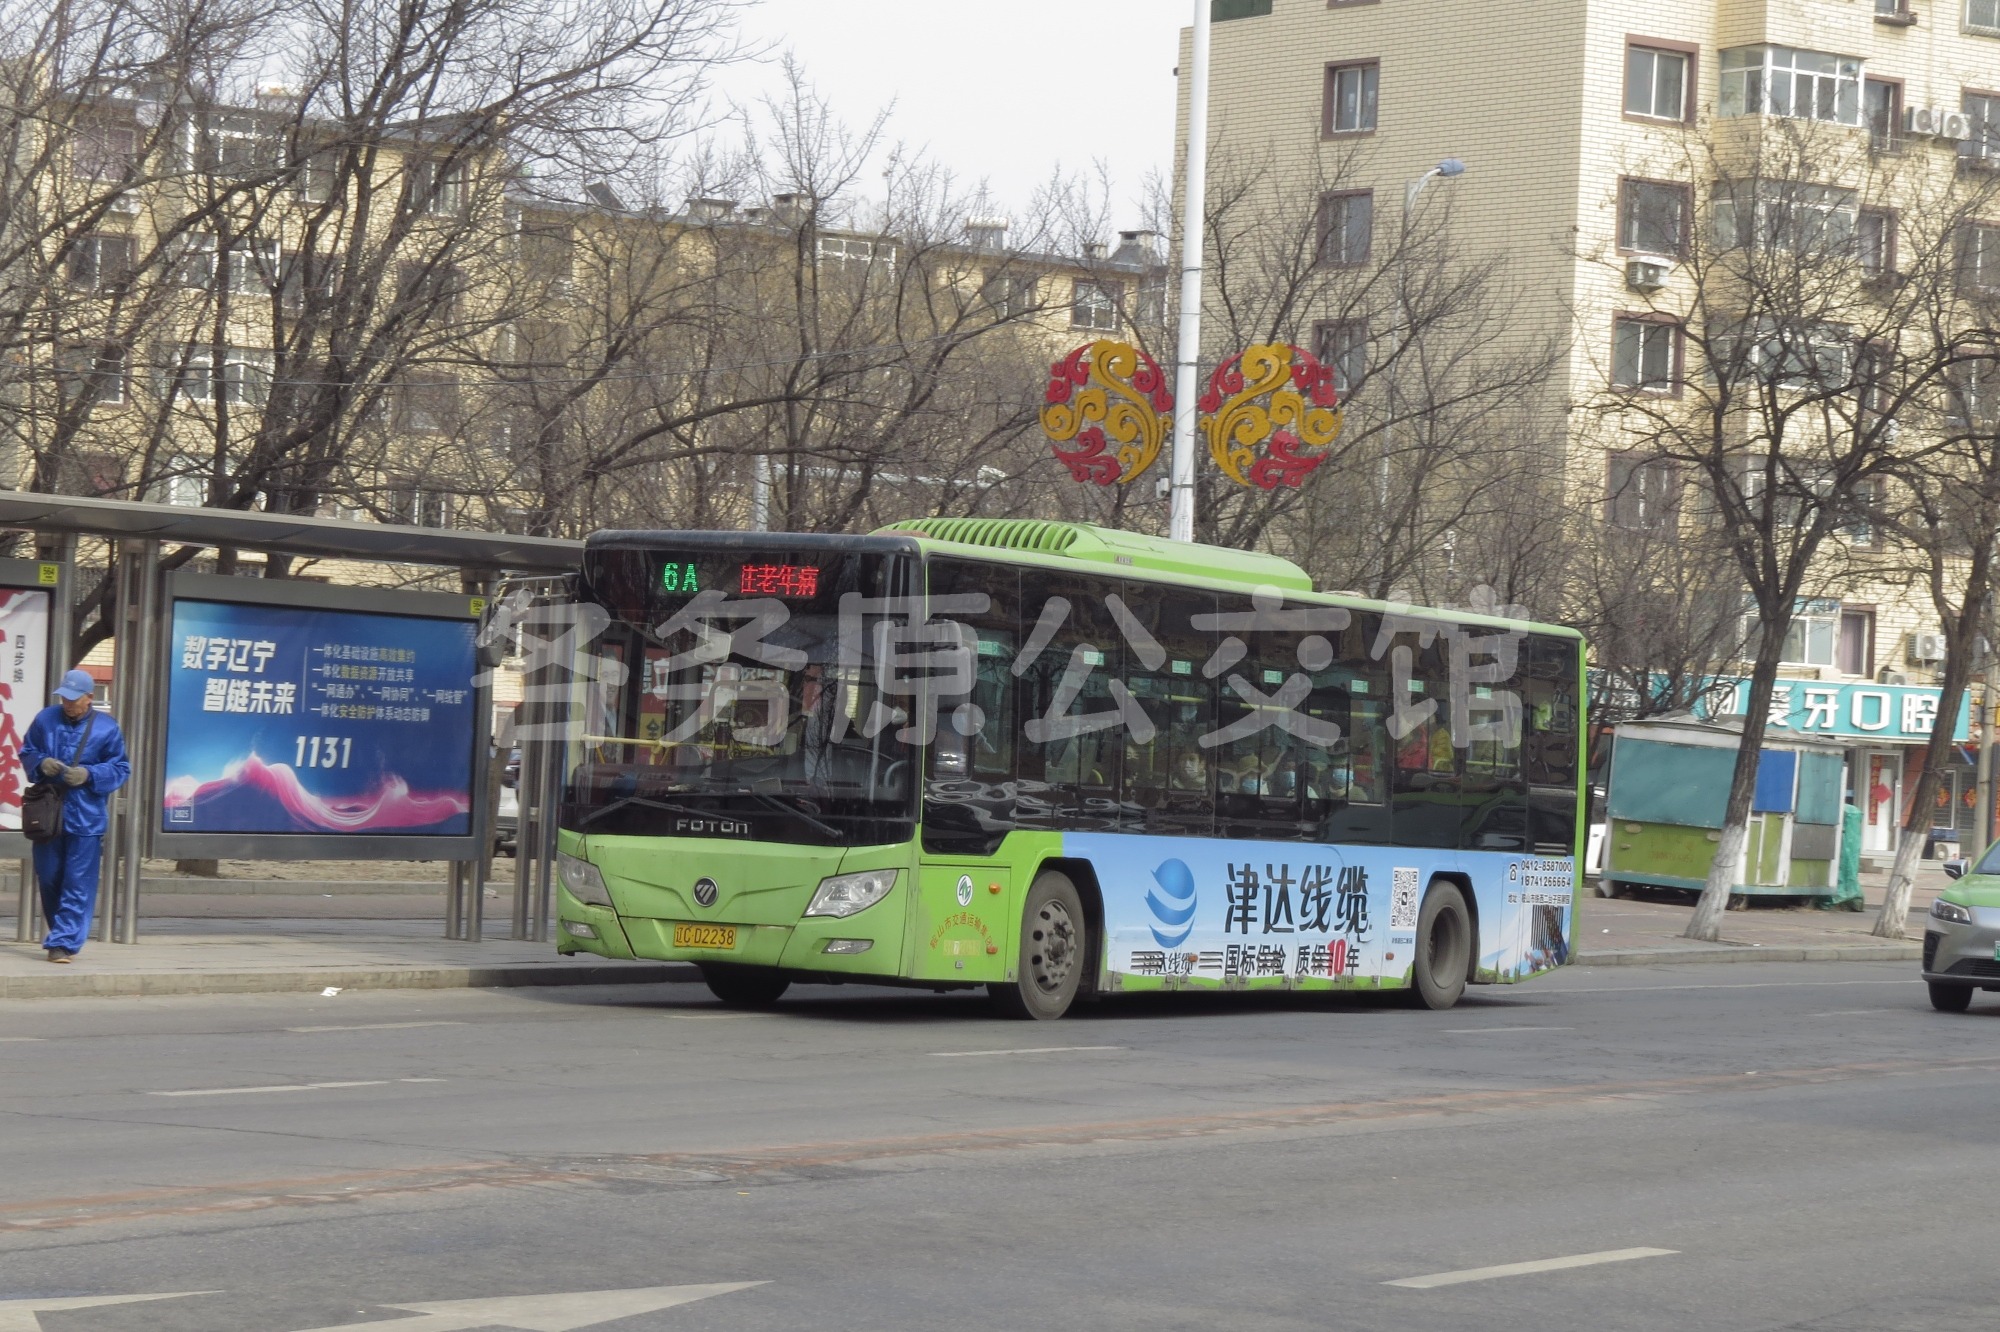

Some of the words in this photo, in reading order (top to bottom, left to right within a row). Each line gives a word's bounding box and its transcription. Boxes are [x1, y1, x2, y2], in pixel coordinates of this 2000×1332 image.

[664, 562, 698, 592] 6A
[182, 635, 276, 673] 数字辽宁
[203, 677, 297, 714] 智链未来
[295, 735, 352, 769] 1131
[676, 818, 748, 835] FOTON
[1224, 863, 1371, 937] 津达线缆
